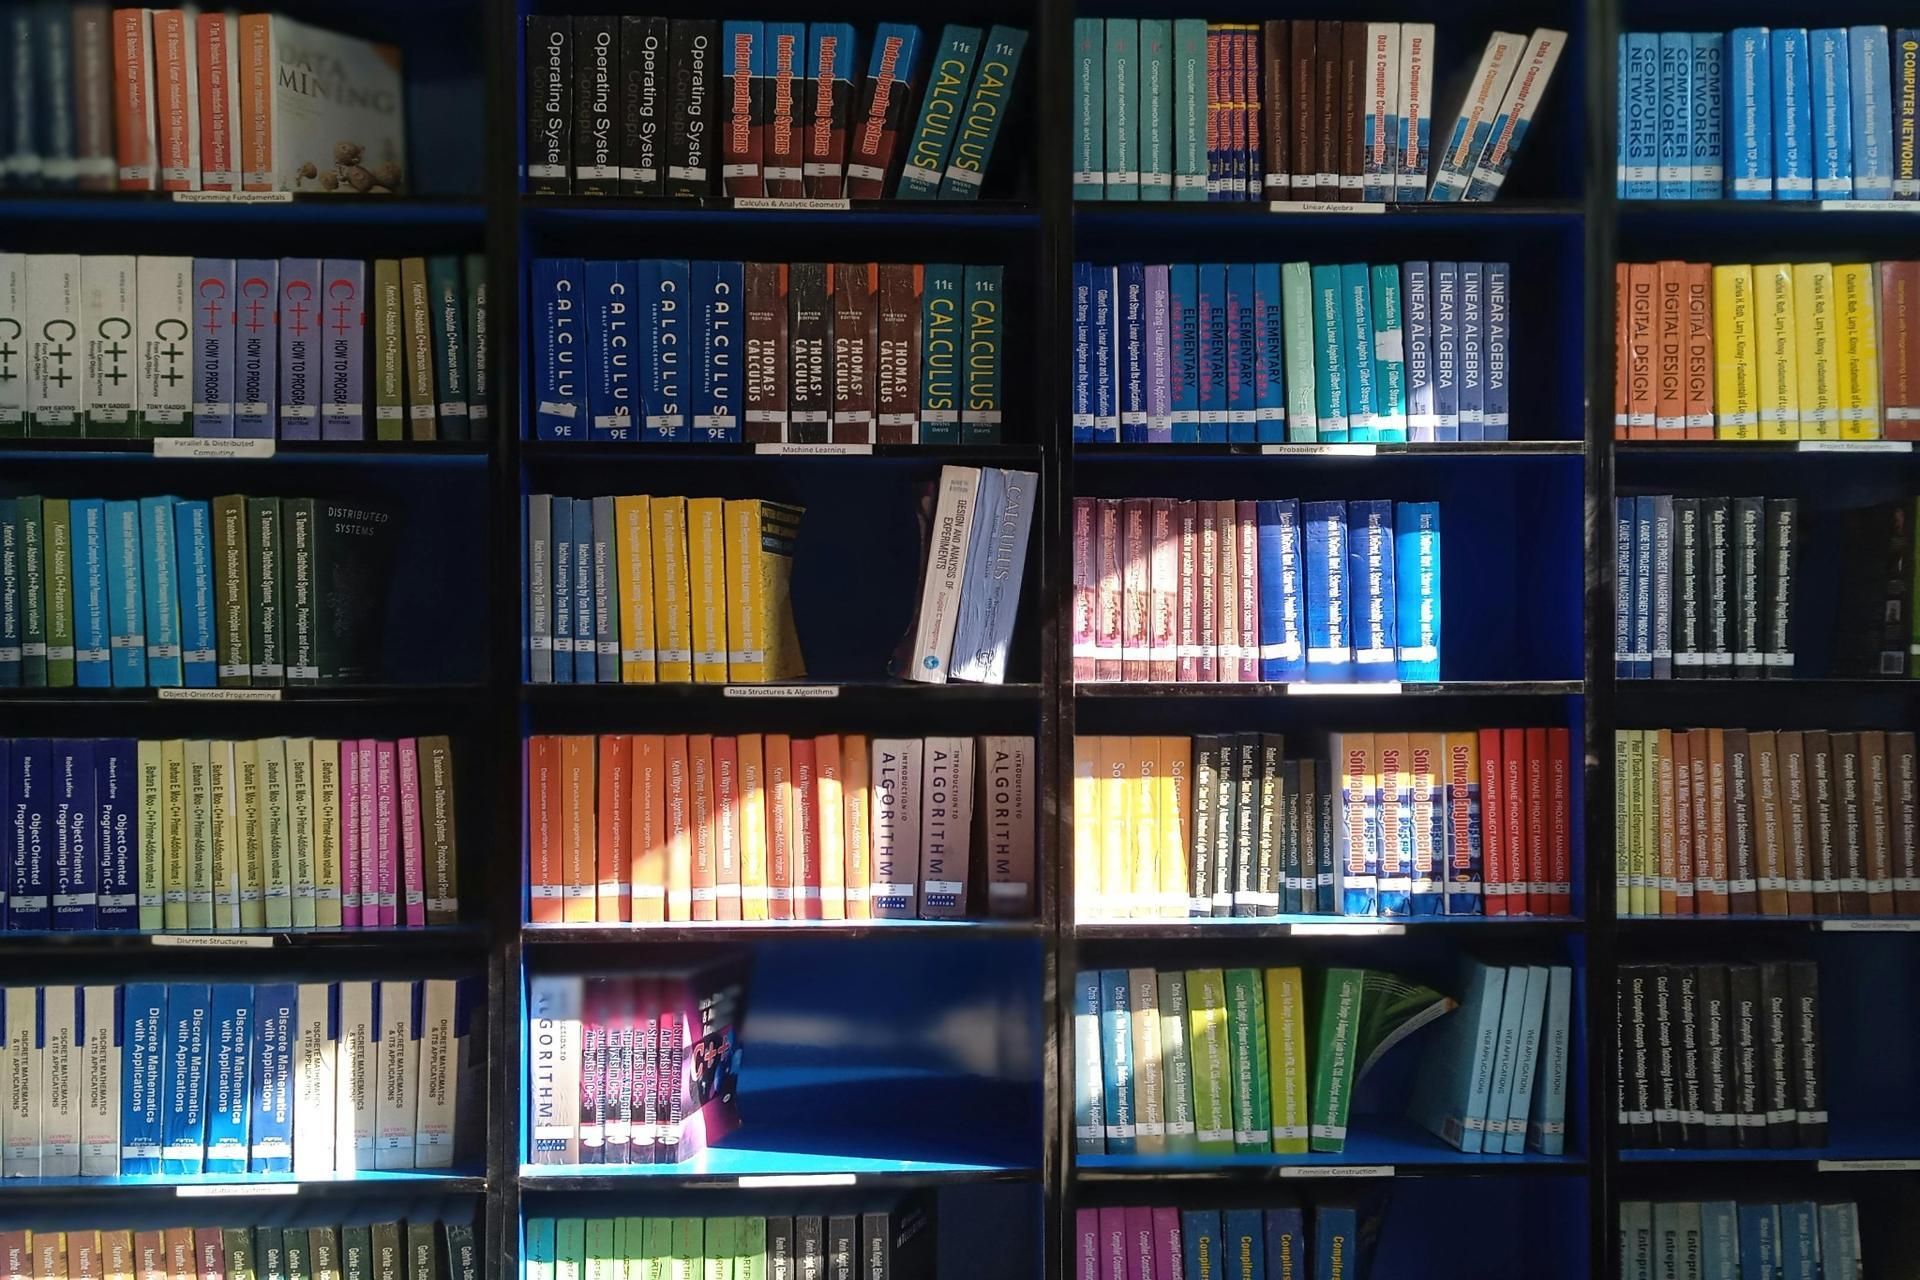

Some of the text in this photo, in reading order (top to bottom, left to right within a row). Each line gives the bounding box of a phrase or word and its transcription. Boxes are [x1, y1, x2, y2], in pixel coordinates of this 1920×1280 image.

[1412, 38, 1423, 55] Data
[278, 65, 395, 114] MINING
[593, 32, 610, 166] Operating Syste
[640, 36, 658, 170] Operating Syste
[687, 36, 707, 169] Operating Syste
[733, 34, 752, 154] Modern Operating Systems
[913, 60, 965, 169] CALCULUS
[956, 62, 1008, 171] CALCULUS
[1410, 65, 1422, 102] Computer
[1631, 48, 1643, 158] NETWORKS
[1645, 48, 1655, 157] COMPUTER
[1663, 48, 1675, 158] NETWORKS
[1677, 48, 1688, 157] COMPUTER
[1903, 52, 1915, 115] COMPUTER
[1407, 103, 1420, 166] Communications
[233, 193, 285, 201] Fundamentals
[809, 202, 846, 210] Geometry
[1326, 204, 1353, 212] Algebra
[200, 278, 226, 336] C++
[243, 278, 268, 334] C++
[287, 281, 311, 337] C++
[329, 279, 355, 336] C++
[557, 280, 572, 396] CALCULU
[1411, 272, 1425, 388] LINEAR ALGEBRA
[1490, 274, 1504, 389] LINEAR ALGEBRA
[98, 318, 131, 386] C++
[155, 320, 188, 387] C++
[205, 340, 220, 403] HOW TO PROGRA
[334, 340, 350, 404] HOW TO PROGRA
[610, 283, 628, 415] CALCULUS
[661, 281, 677, 414] CALCULUS
[714, 282, 730, 415] CALCULUS
[748, 338, 760, 402] CALCULUS
[881, 340, 892, 403] CALCULUS
[928, 299, 953, 409] CALCULUS
[971, 300, 996, 411] CALCULUS
[1240, 308, 1252, 388] ELEMENTARY
[1268, 306, 1280, 384] ELEMENTARY
[1634, 283, 1650, 401] DIGITAL DESIGN
[1690, 284, 1706, 401] DIGITAL DESIGN
[660, 429, 676, 439] 9E
[709, 429, 725, 438] 9E
[815, 447, 846, 455] Learning
[328, 507, 388, 522] DISTRIBUTED
[335, 523, 375, 536] SYSTEMS
[936, 517, 954, 570] EXPERIMENTS
[945, 500, 967, 589] DESIGN AND ANALYSIS OF
[993, 486, 1022, 581] CALCULUS
[577, 565, 590, 588] Learning
[580, 544, 590, 563] Machine
[163, 691, 223, 699] Object-Oriented
[748, 688, 784, 696] Structures
[795, 689, 833, 697] Algorithms
[170, 762, 181, 783] Barbara
[901, 752, 909, 821] INTRODUCTION TO
[15, 804, 27, 864] Programming
[996, 751, 1010, 880] ALGORITHM
[1383, 751, 1401, 872] Software Engineering
[1453, 747, 1471, 869] Software Engineering
[1510, 760, 1521, 882] SOFTWARE PROJECT MANAGEMEN
[29, 813, 41, 884] Object Oriented
[18, 877, 27, 895] C++
[177, 937, 207, 945] Discrete
[691, 1033, 731, 1082] C++
[1553, 1030, 1565, 1095] WEB APPLICATIONS
[1683, 979, 1697, 1078] Cloud Computing Concepts Technology
[262, 1019, 275, 1112] with Applications
[276, 1007, 290, 1123] Discrete Mathematics
